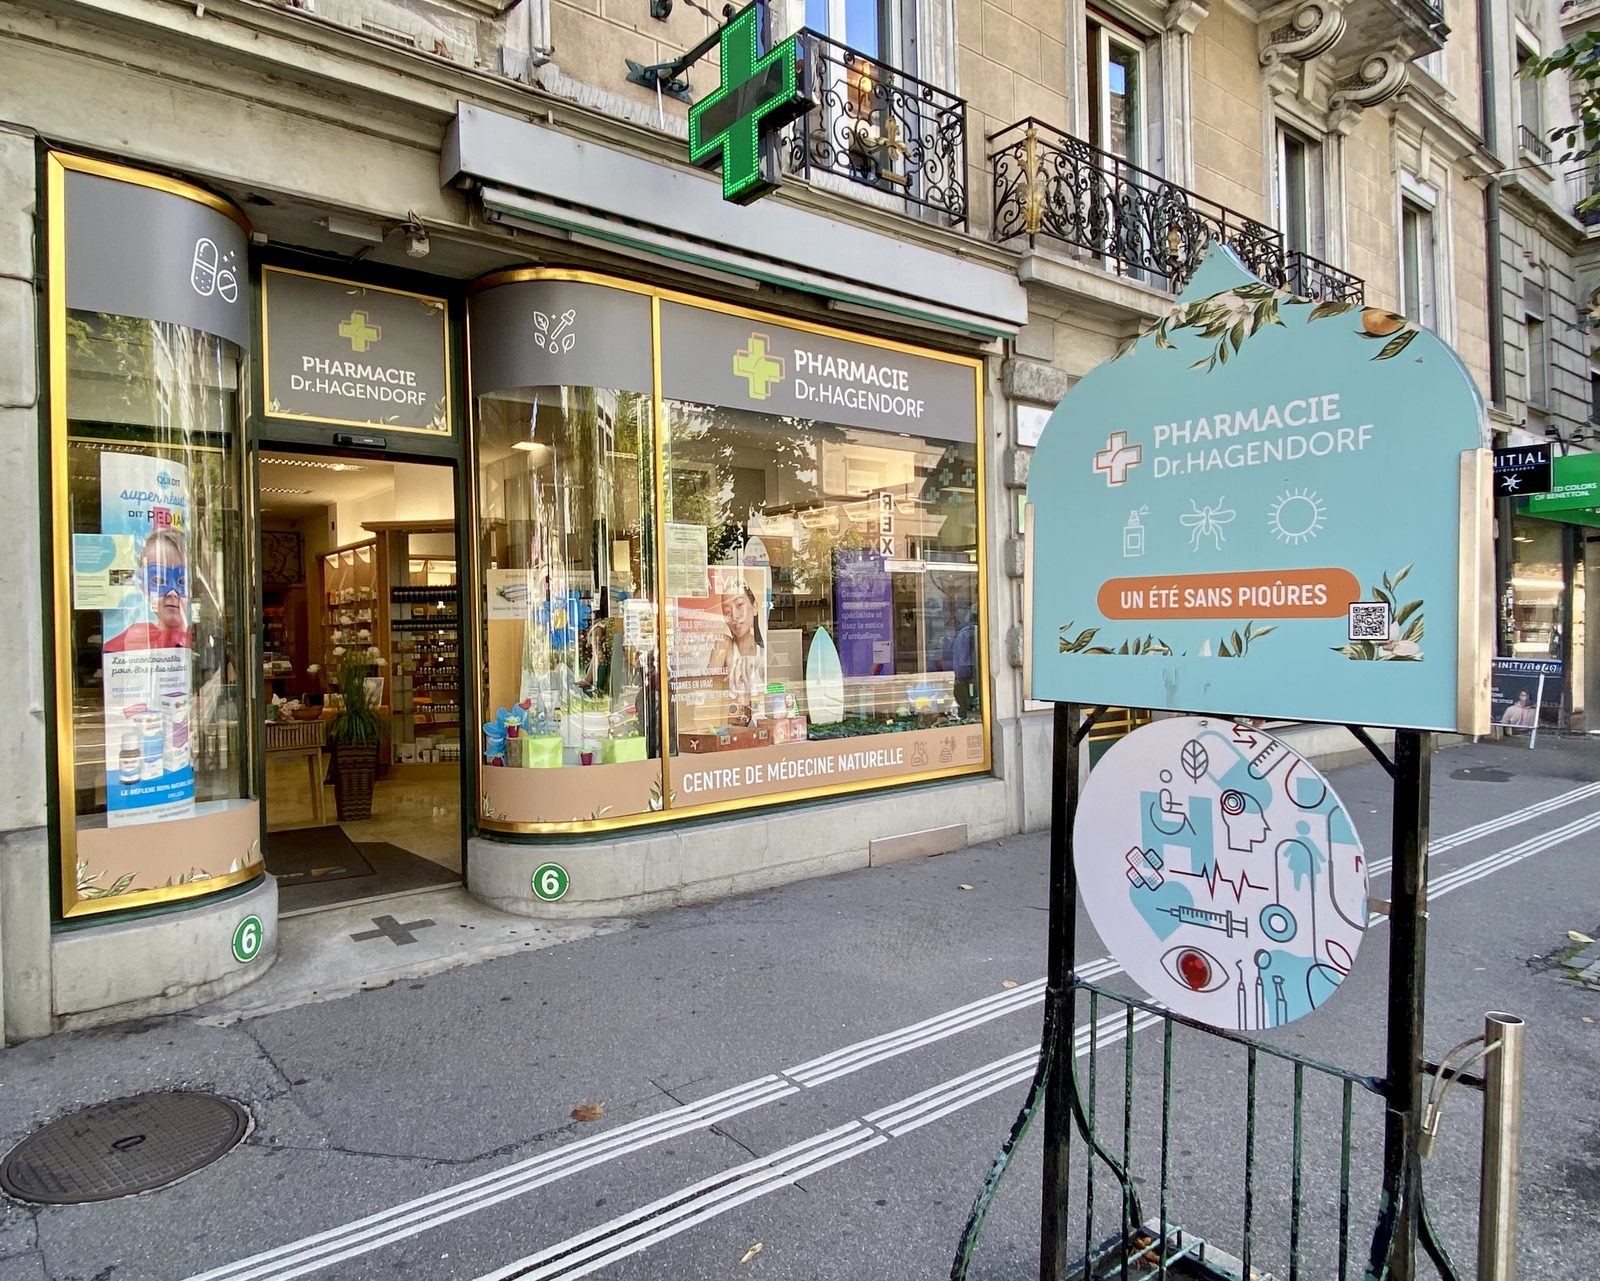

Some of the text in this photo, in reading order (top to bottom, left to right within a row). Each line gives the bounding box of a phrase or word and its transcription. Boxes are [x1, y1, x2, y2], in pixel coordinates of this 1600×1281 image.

[302, 356, 417, 387] PHARMACIE
[794, 349, 909, 392] PHARMACIE
[291, 375, 427, 406] Dr.HAGENDORF
[795, 379, 925, 419] Dr.HAGENDORF
[1154, 393, 1341, 448] PHARMACIE
[1154, 424, 1374, 478] Dr.HAGENDORF
[157, 475, 181, 487] QUI DIT
[1564, 482, 1597, 491] COLORS
[120, 489, 161, 506] super
[128, 510, 144, 518] DIT
[1120, 580, 1328, 610] UN ÉTÉ SANS PIQÛRES
[111, 656, 127, 665] Les
[111, 668, 133, 678] pour
[671, 679, 713, 690] TISANES EN VRAC
[683, 747, 904, 793] CENTRE DE MÉDECINE NATURELLE
[120, 789, 129, 797] LE
[541, 869, 560, 896] 6
[241, 923, 256, 954] 6
